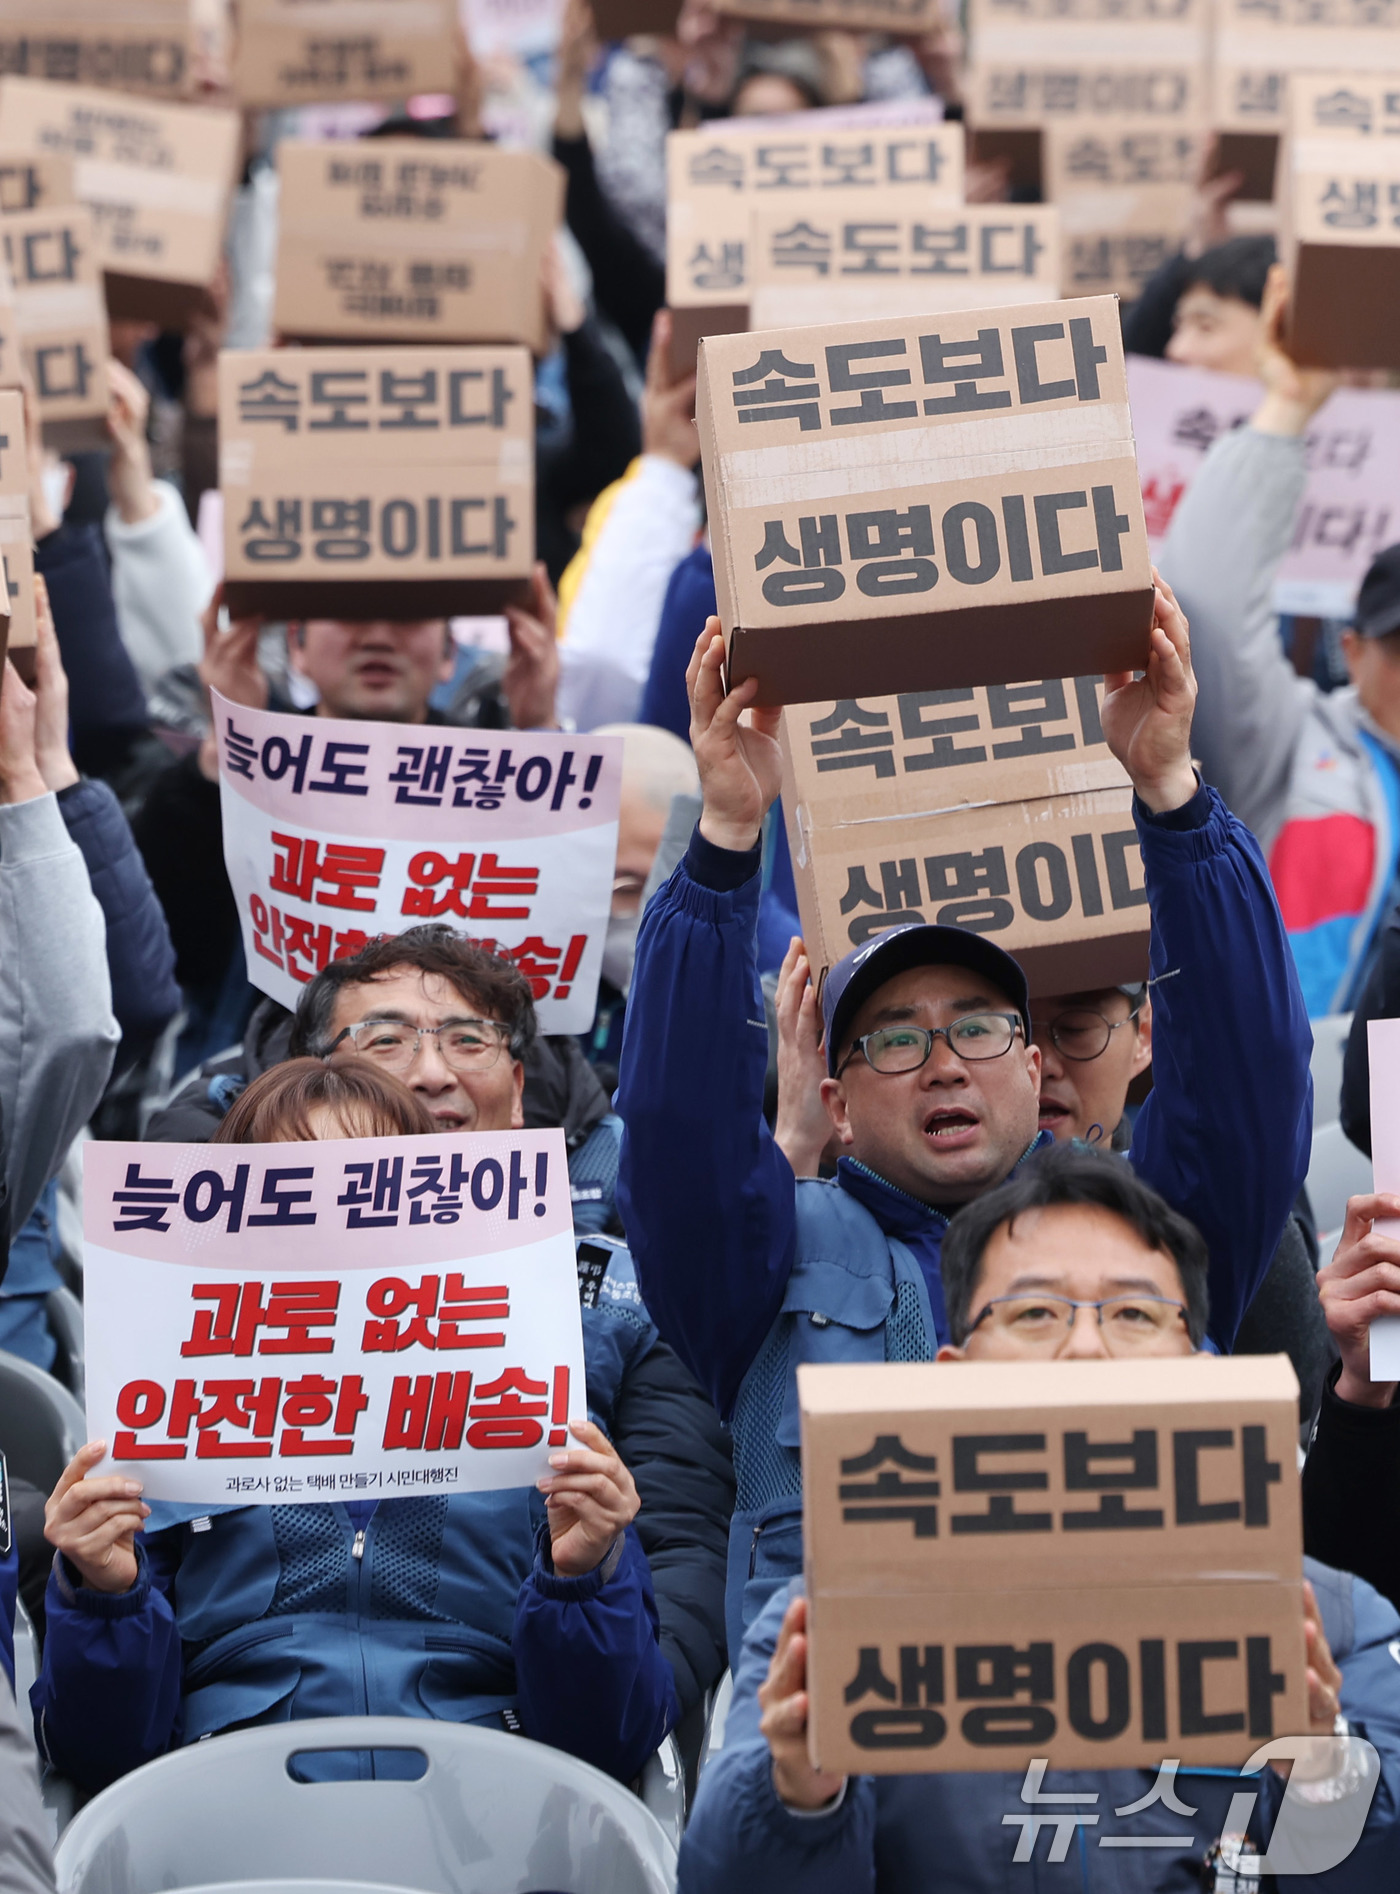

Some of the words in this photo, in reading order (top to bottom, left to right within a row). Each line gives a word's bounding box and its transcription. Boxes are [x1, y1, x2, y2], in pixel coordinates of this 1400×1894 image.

[687, 139, 946, 191] 속도보다
[772, 221, 1044, 278] 속도보다
[238, 367, 514, 433] 속도보다
[731, 316, 1108, 432] 속도보다
[239, 495, 517, 564] 생명이다
[754, 485, 1130, 608] 생명이다
[223, 717, 370, 796] 늦어도
[388, 745, 604, 811] 괜찮아!
[269, 830, 386, 913] 과로
[400, 850, 540, 920] 없는
[112, 1163, 317, 1233] 늦어도
[337, 1150, 549, 1229] 괜찮아!
[180, 1280, 341, 1357] 과로
[361, 1272, 510, 1353] 없는
[112, 1374, 369, 1461] 안전한
[382, 1365, 571, 1451] 배송!
[225, 1475, 271, 1493] 과로사
[274, 1475, 304, 1493] 없는
[306, 1473, 337, 1491] 택배
[339, 1471, 384, 1490] 만들기
[386, 1466, 459, 1487] 시민대행진
[838, 1425, 1282, 1539] 속도보다
[844, 1636, 1286, 1751] 생명이다
